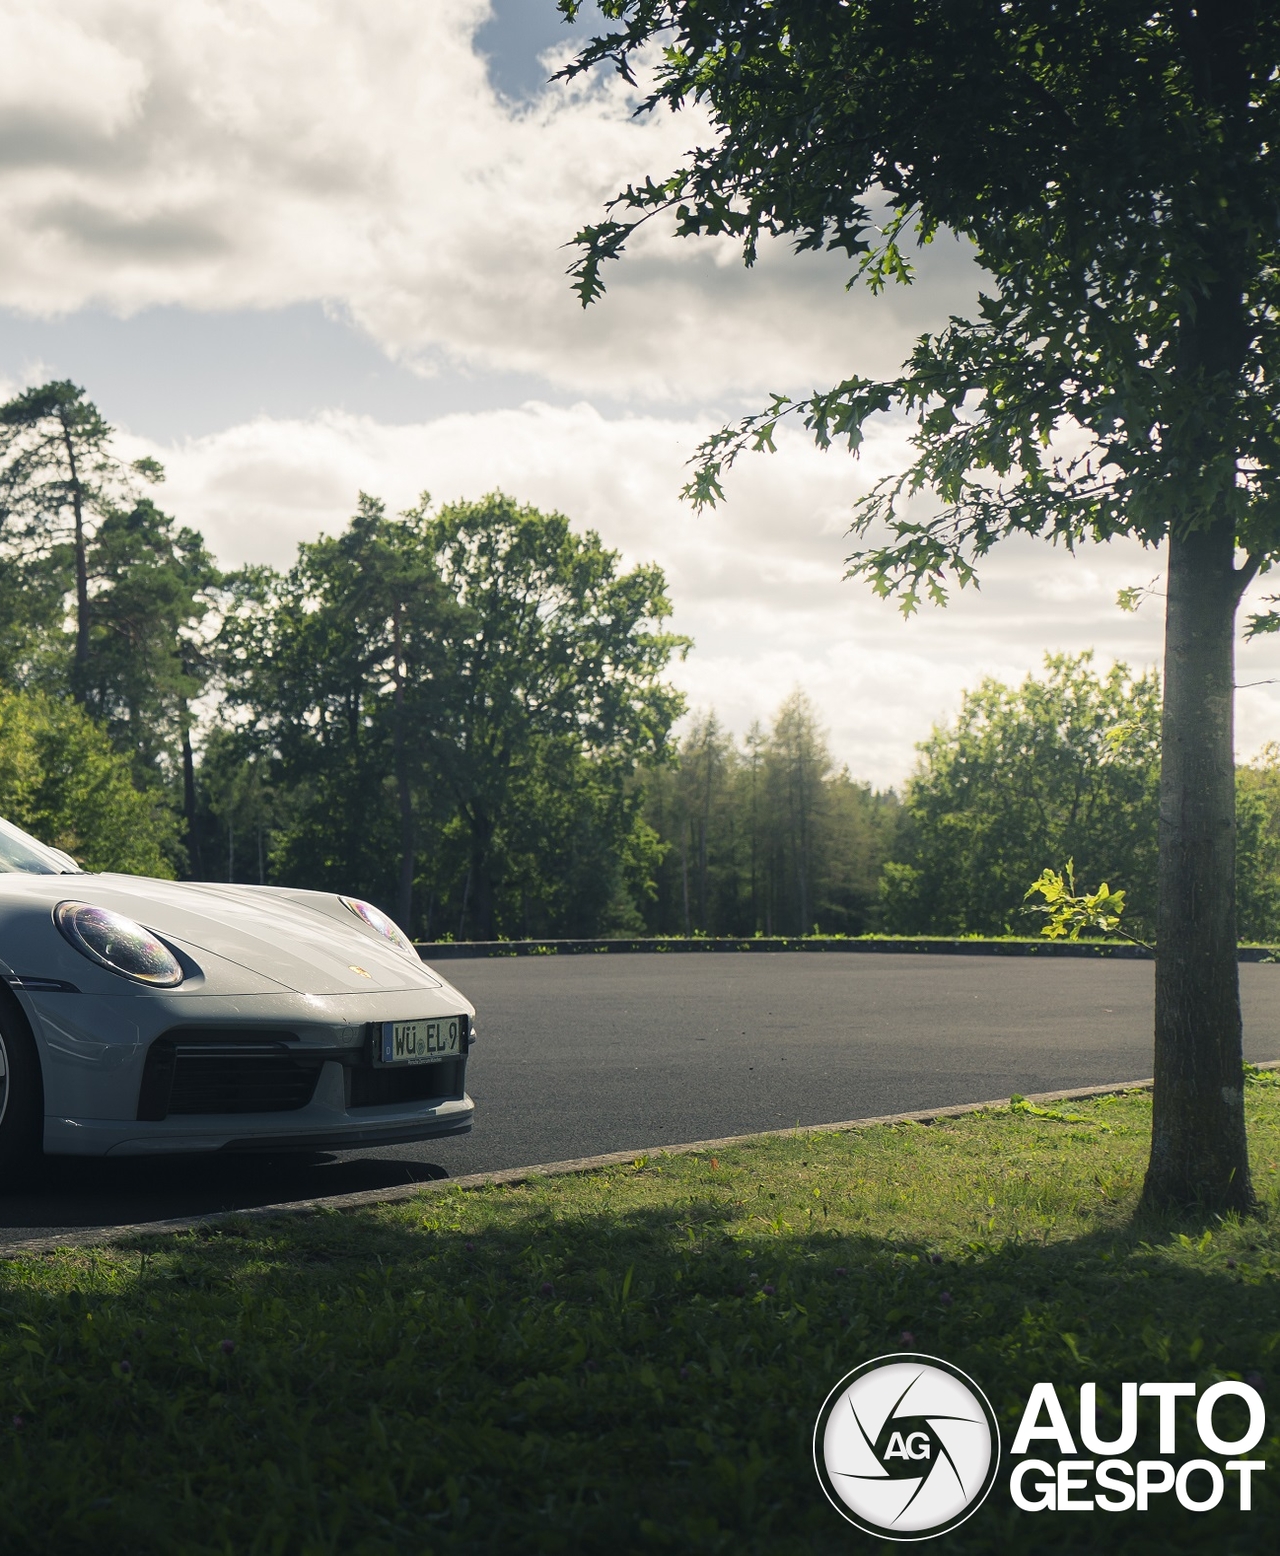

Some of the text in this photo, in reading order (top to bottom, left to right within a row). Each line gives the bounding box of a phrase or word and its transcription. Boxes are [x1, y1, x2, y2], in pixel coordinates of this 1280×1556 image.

[395, 1022, 457, 1055] WÜ EL 9
